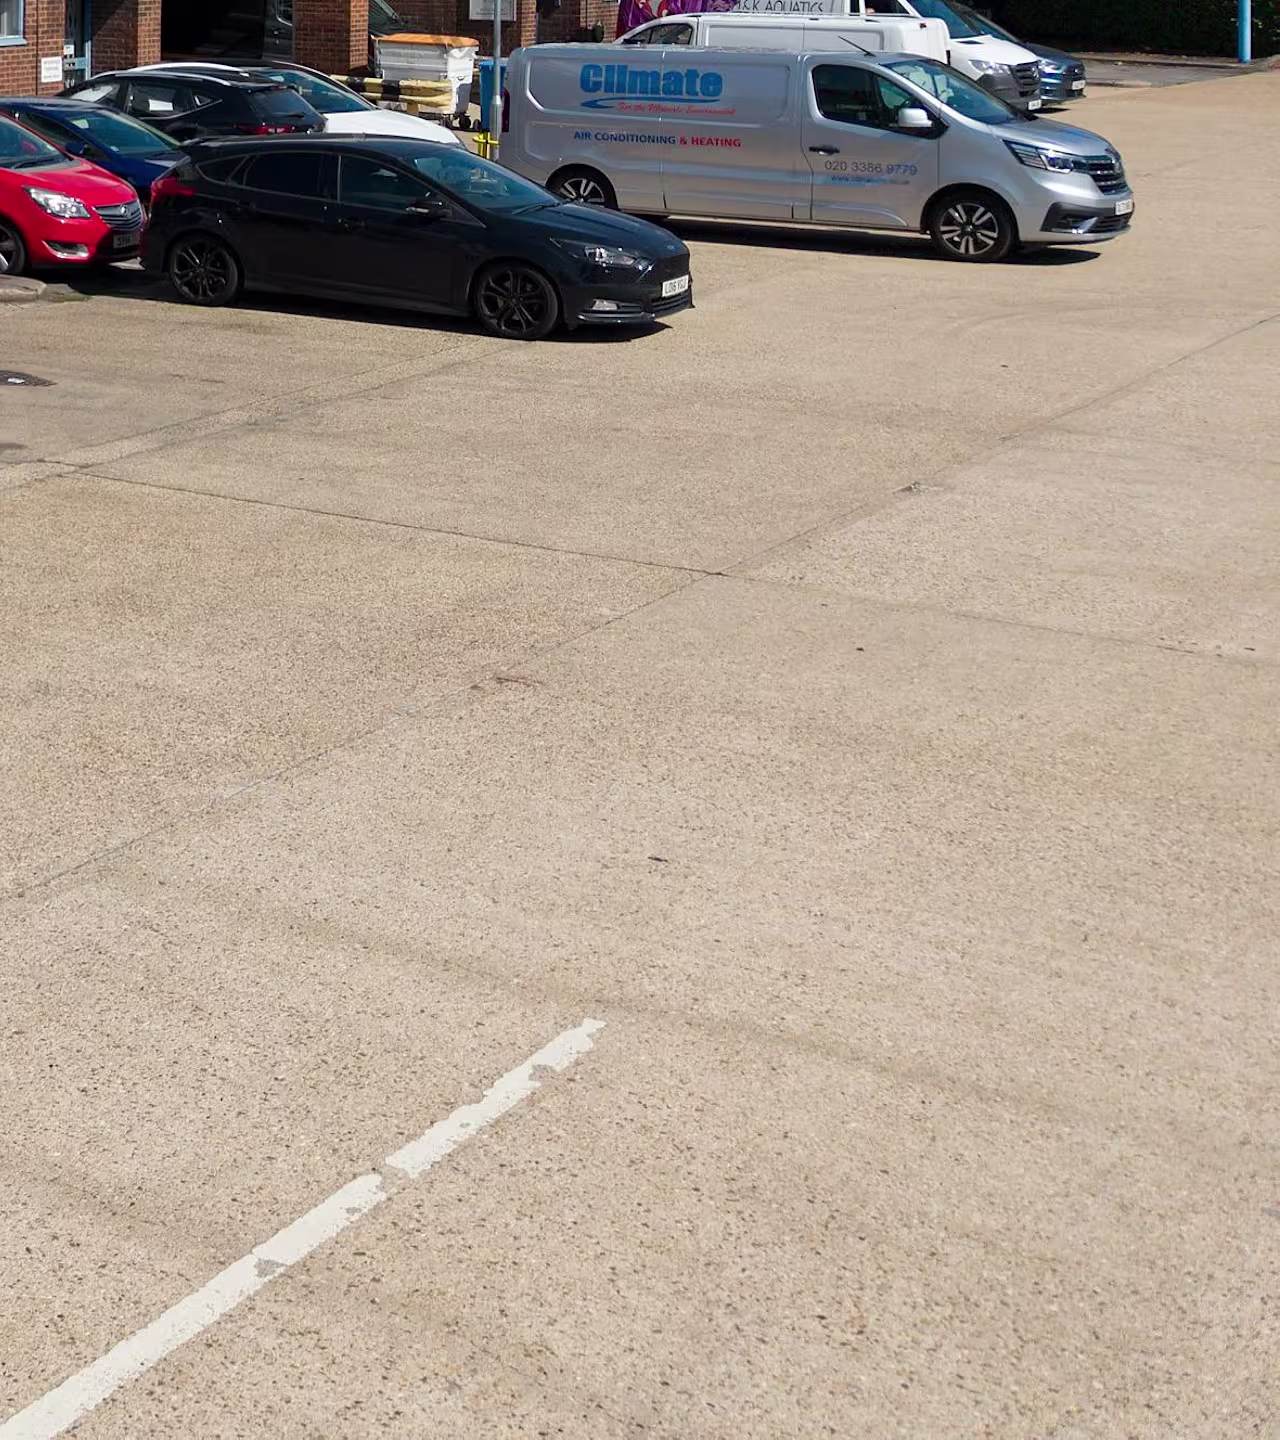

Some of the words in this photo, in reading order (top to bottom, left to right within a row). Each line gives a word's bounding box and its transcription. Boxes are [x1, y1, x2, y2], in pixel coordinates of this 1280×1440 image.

[765, 0, 824, 12] AQUATICS
[580, 63, 723, 98] Climate
[573, 131, 591, 140] AIR
[594, 131, 676, 145] CONDITIONING
[679, 137, 688, 146] &
[691, 137, 741, 148] HEATING
[824, 160, 848, 172] 020
[886, 163, 918, 176] 9779
